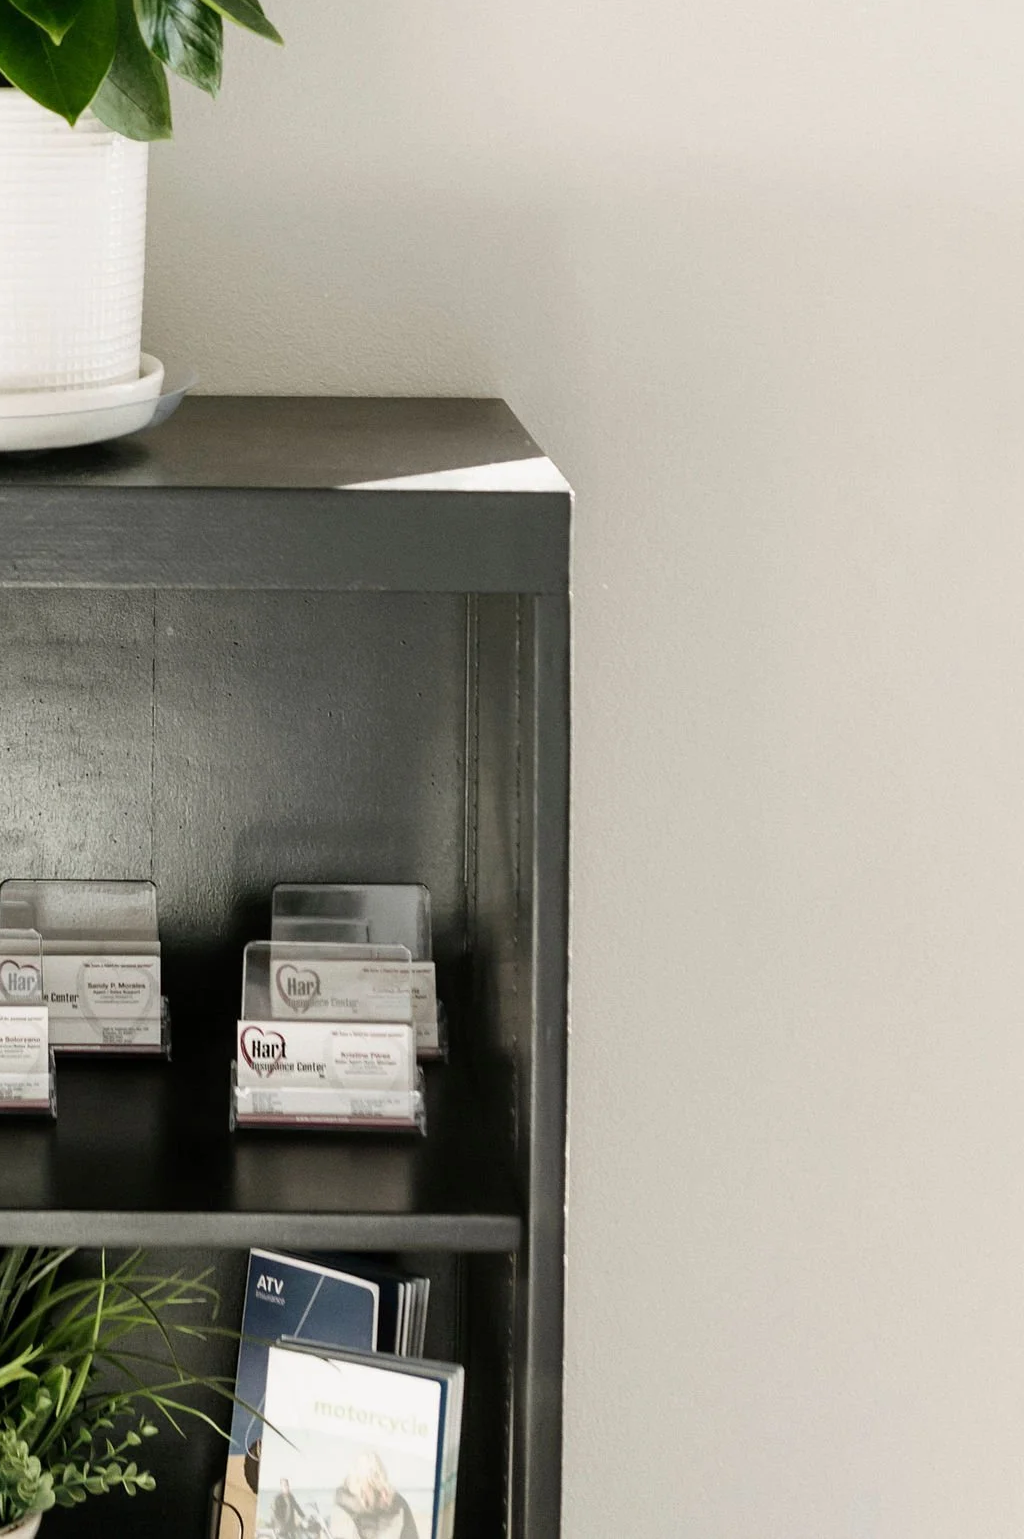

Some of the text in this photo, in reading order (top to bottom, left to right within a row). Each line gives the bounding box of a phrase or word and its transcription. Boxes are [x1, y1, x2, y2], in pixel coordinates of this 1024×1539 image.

[287, 977, 321, 996] Hart
[50, 992, 79, 1003] Center
[252, 1040, 286, 1059] Hart
[296, 1062, 326, 1072] Center
[256, 1273, 284, 1295] ATV
[313, 1400, 430, 1439] motorcycle
